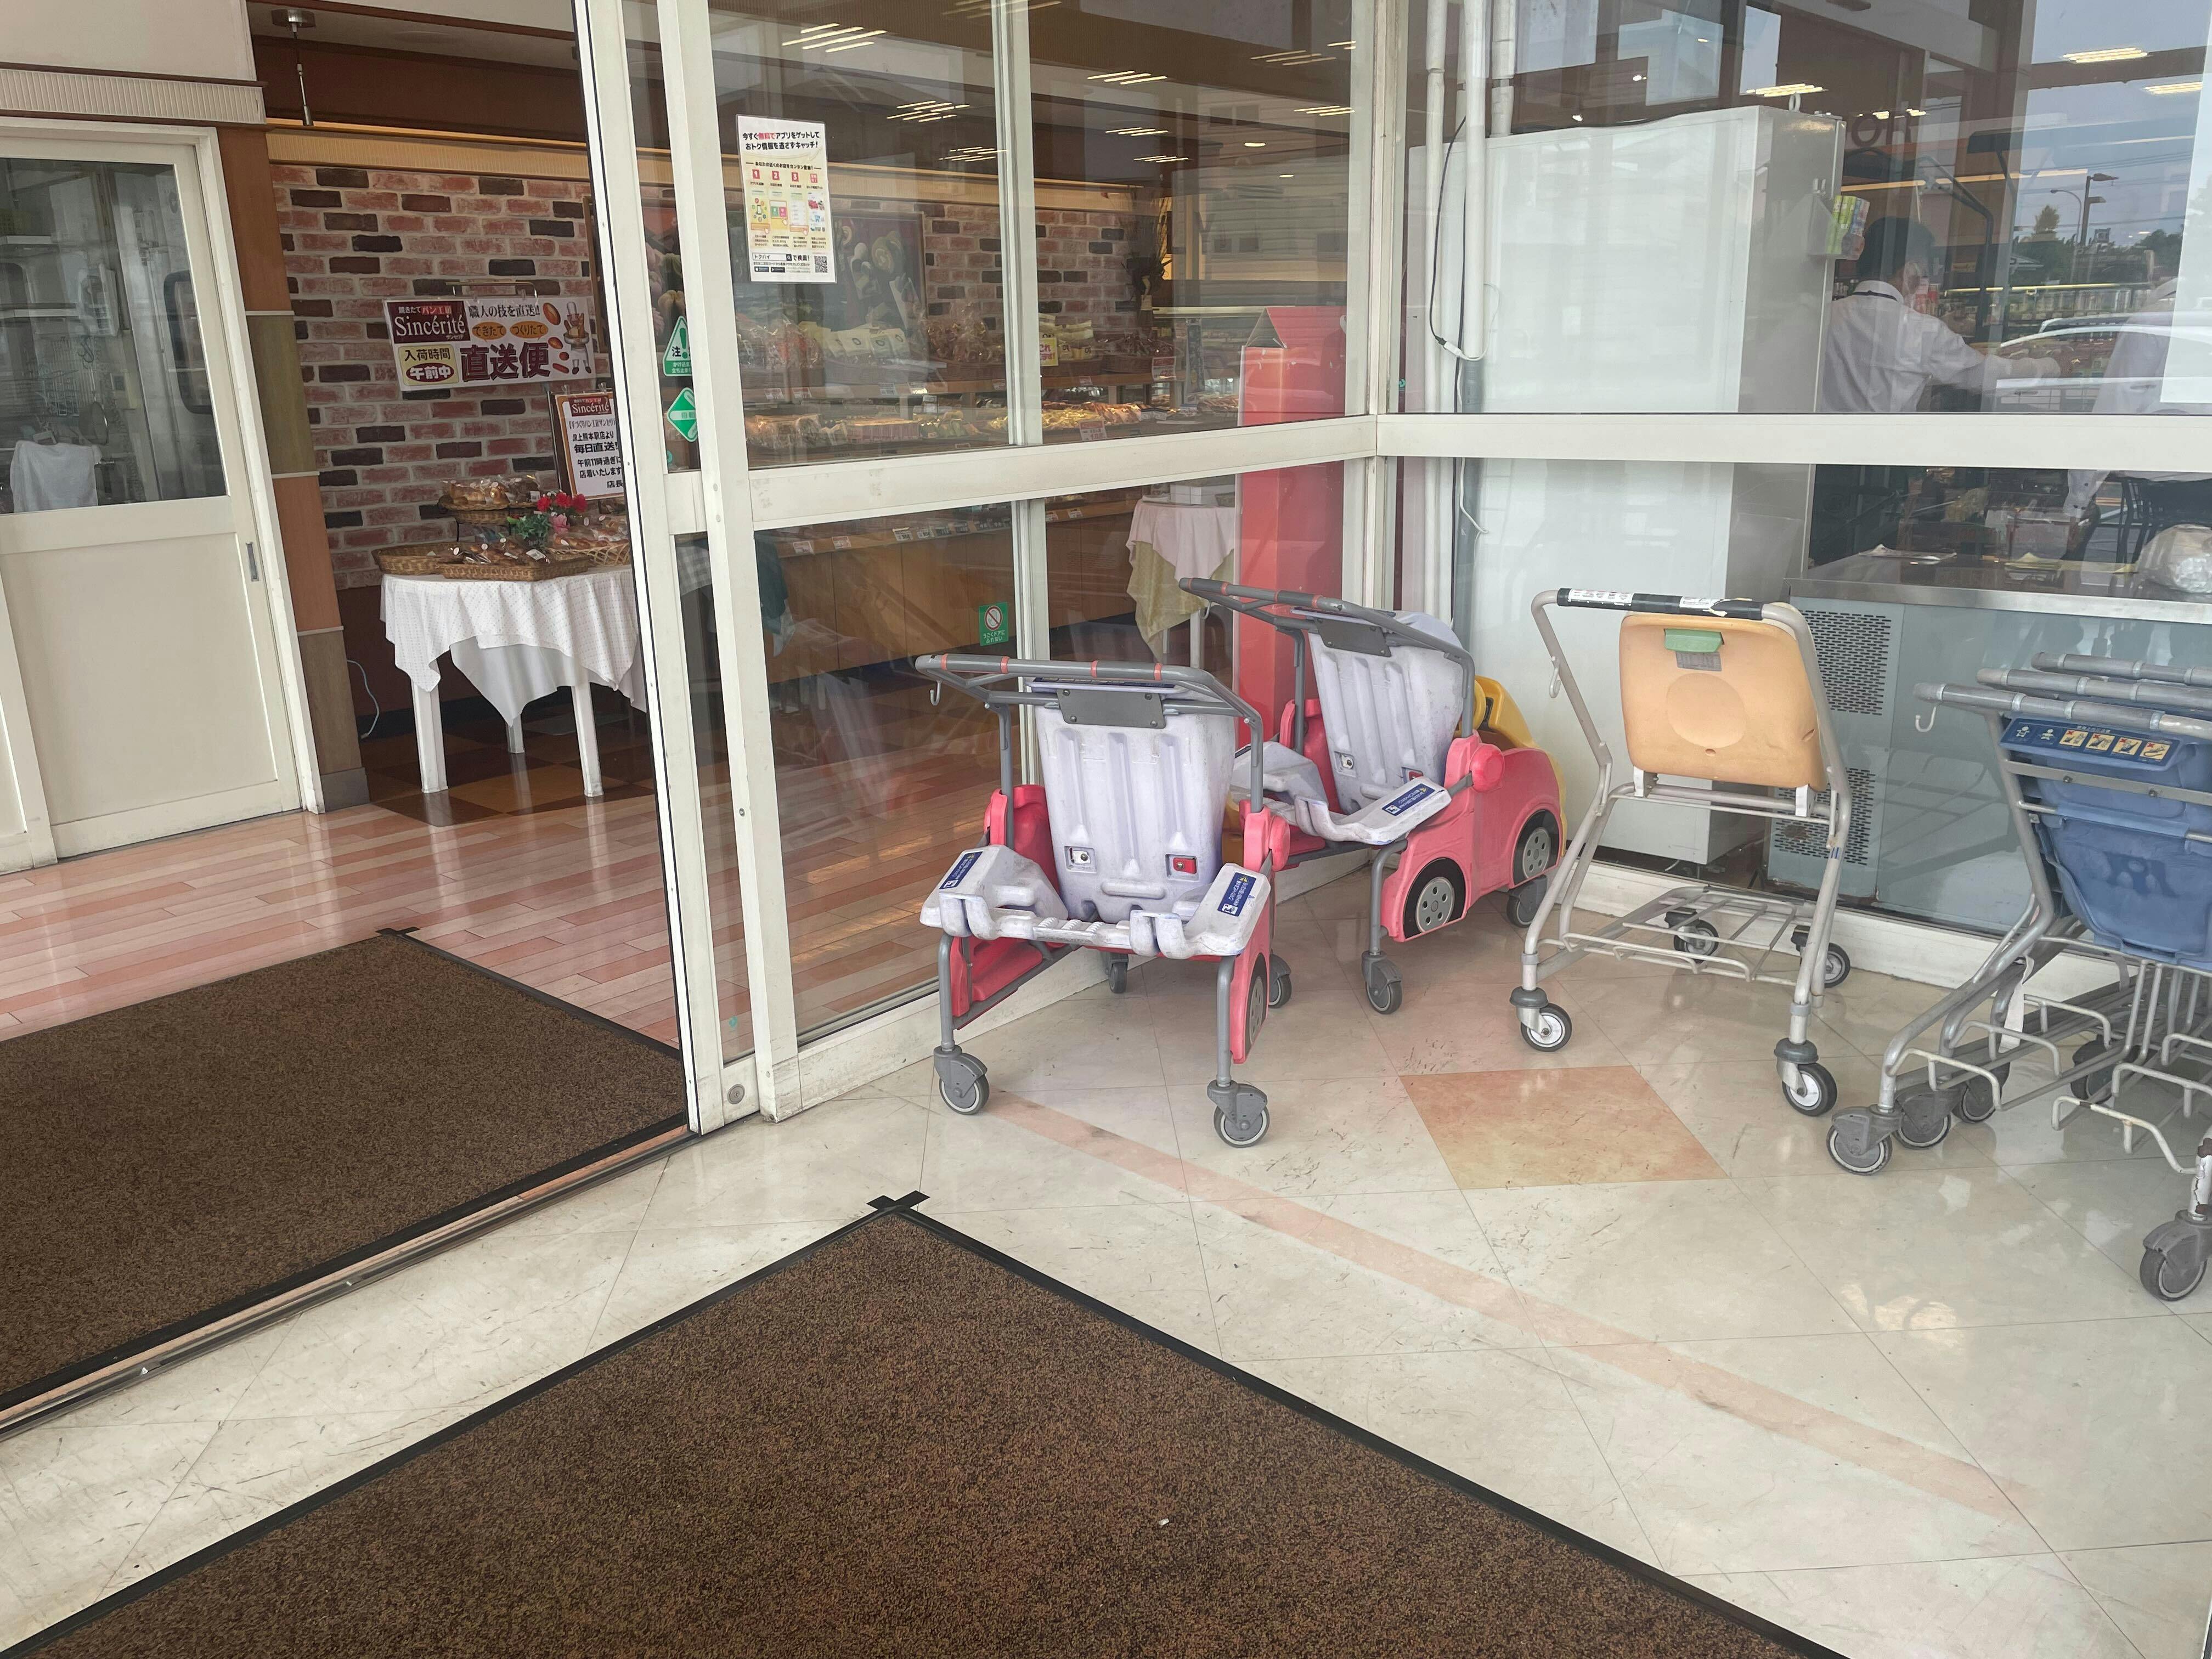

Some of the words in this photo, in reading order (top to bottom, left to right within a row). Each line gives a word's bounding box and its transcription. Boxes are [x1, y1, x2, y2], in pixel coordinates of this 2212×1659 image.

[394, 314, 466, 337] Sincérité
[404, 347, 451, 362] 入荷時間
[460, 341, 551, 382] 直送便
[409, 365, 452, 380] 午前中
[572, 401, 610, 414] Sincérité
